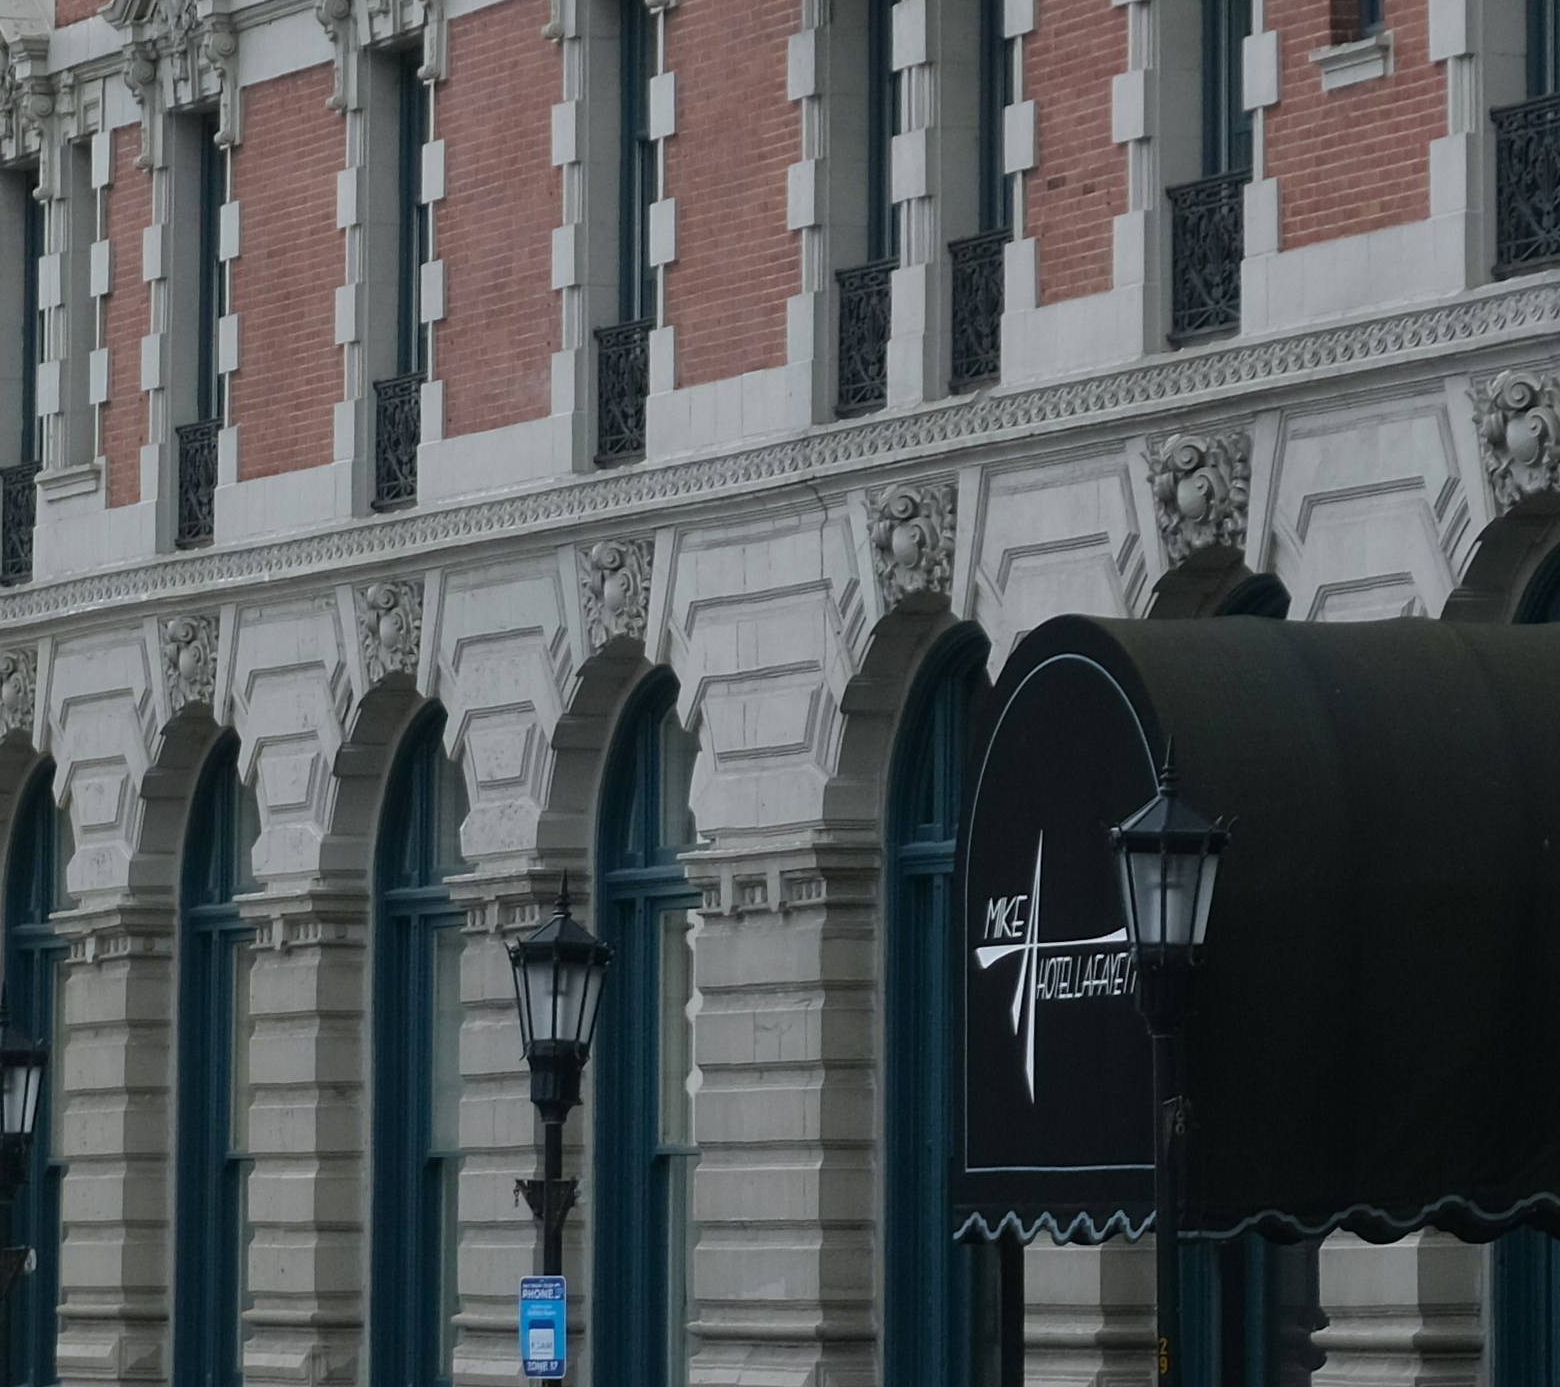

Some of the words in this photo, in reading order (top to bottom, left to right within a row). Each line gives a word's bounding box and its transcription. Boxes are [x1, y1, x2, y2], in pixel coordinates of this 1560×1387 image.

[984, 895, 1028, 940] MIKE
[1036, 956, 1073, 1000] HOTEL
[1074, 952, 1138, 998] LAFAYET
[1159, 1337, 1168, 1375] 29
